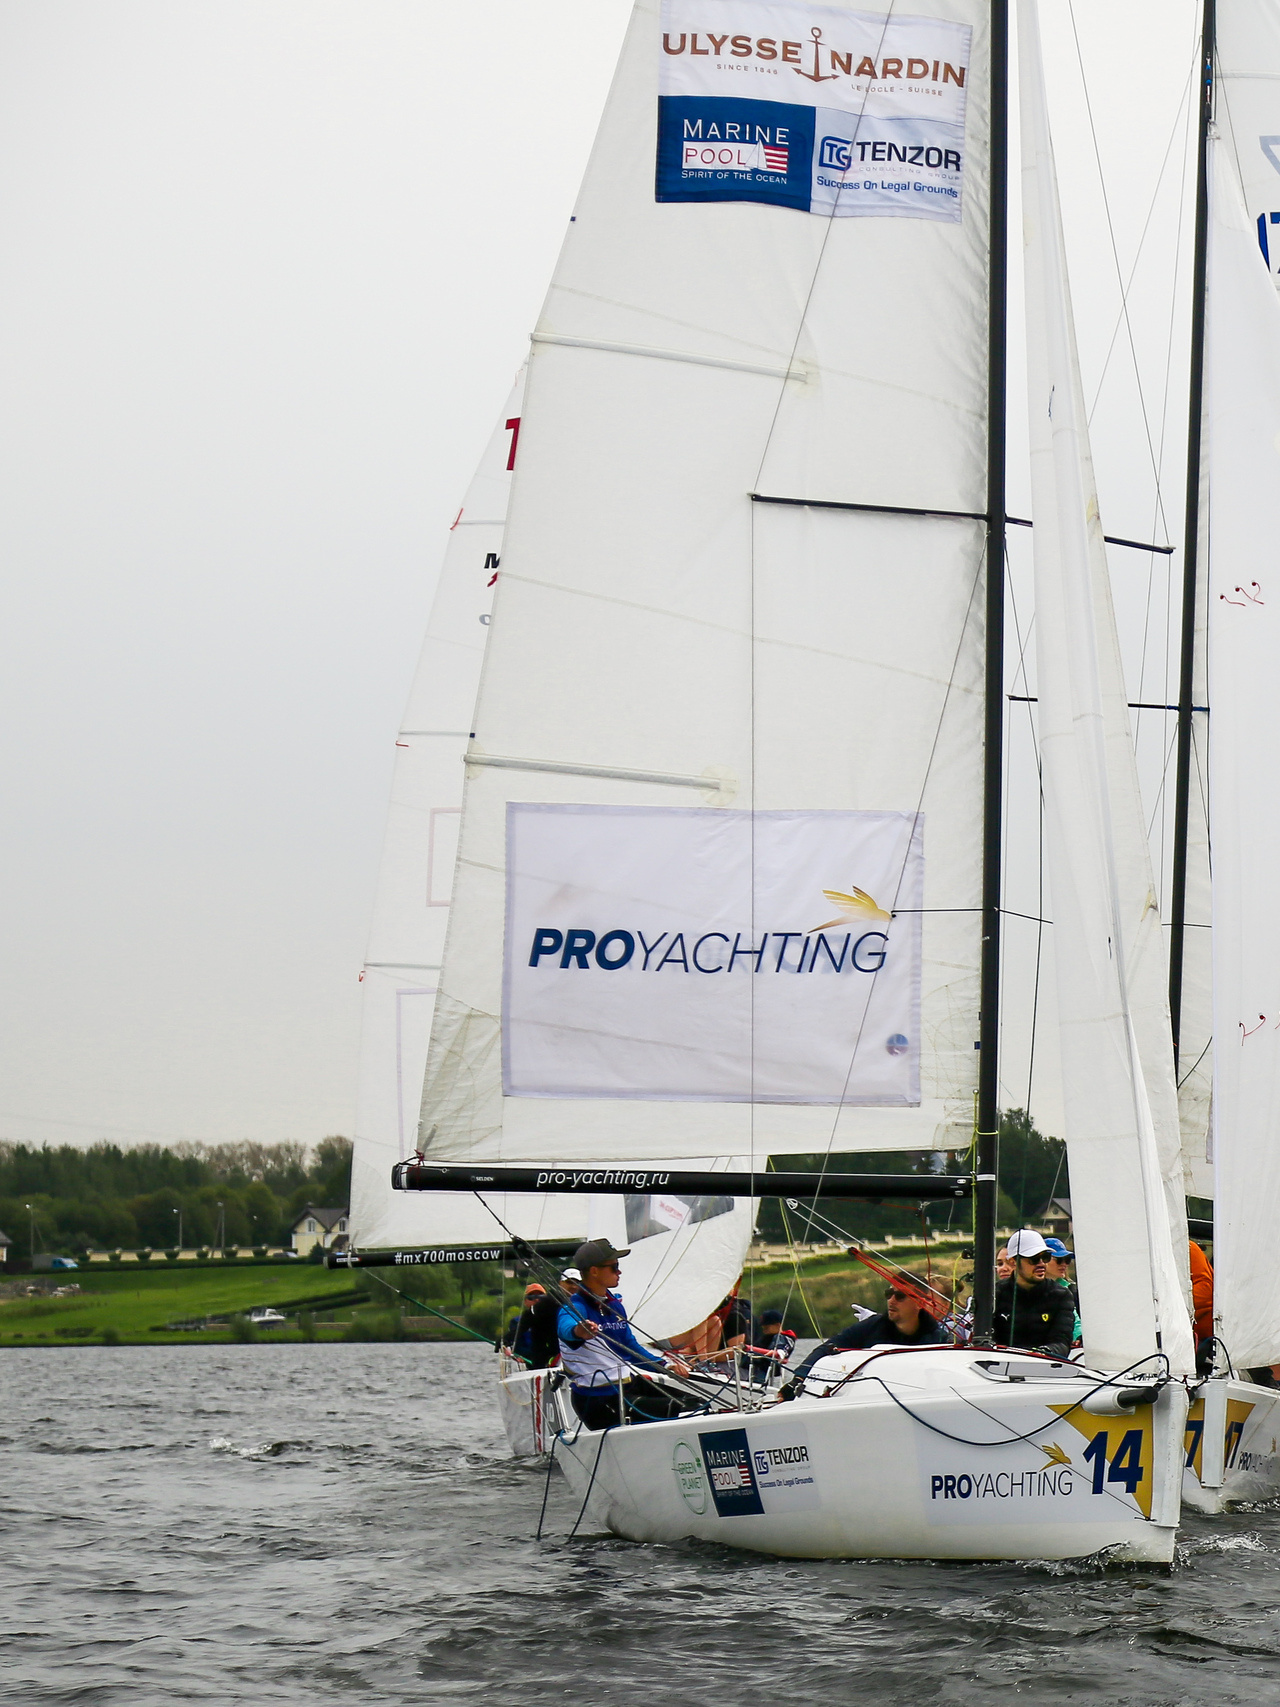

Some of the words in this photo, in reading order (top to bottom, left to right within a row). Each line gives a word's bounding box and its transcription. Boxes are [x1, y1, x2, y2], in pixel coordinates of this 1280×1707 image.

[662, 32, 803, 65] ULYSSE
[830, 49, 966, 88] NARDIN
[716, 63, 749, 72] SINCE
[754, 66, 778, 75] 1846
[851, 84, 861, 92] LE
[908, 86, 943, 97] SUISSE
[683, 118, 790, 145] MARINE
[685, 147, 747, 166] POOL
[856, 141, 961, 172] TENZOR
[681, 170, 713, 179] SPIRIT
[716, 171, 730, 179] OF
[733, 172, 752, 181] THE
[755, 174, 787, 185] OCEAN
[816, 176, 860, 190] Success
[863, 180, 878, 190] On
[881, 181, 911, 193] Legal
[913, 182, 959, 198] Grounds
[529, 928, 889, 974] PROYACHTING
[536, 1169, 670, 1189] pro-yachting.ru
[394, 1250, 500, 1264] #mx700moscow
[707, 1450, 747, 1466] MARINE
[766, 1446, 809, 1465] TENZOR
[1082, 1429, 1144, 1495] 14
[712, 1473, 737, 1486] POOL
[931, 1470, 1073, 1499] PROYACHTING
